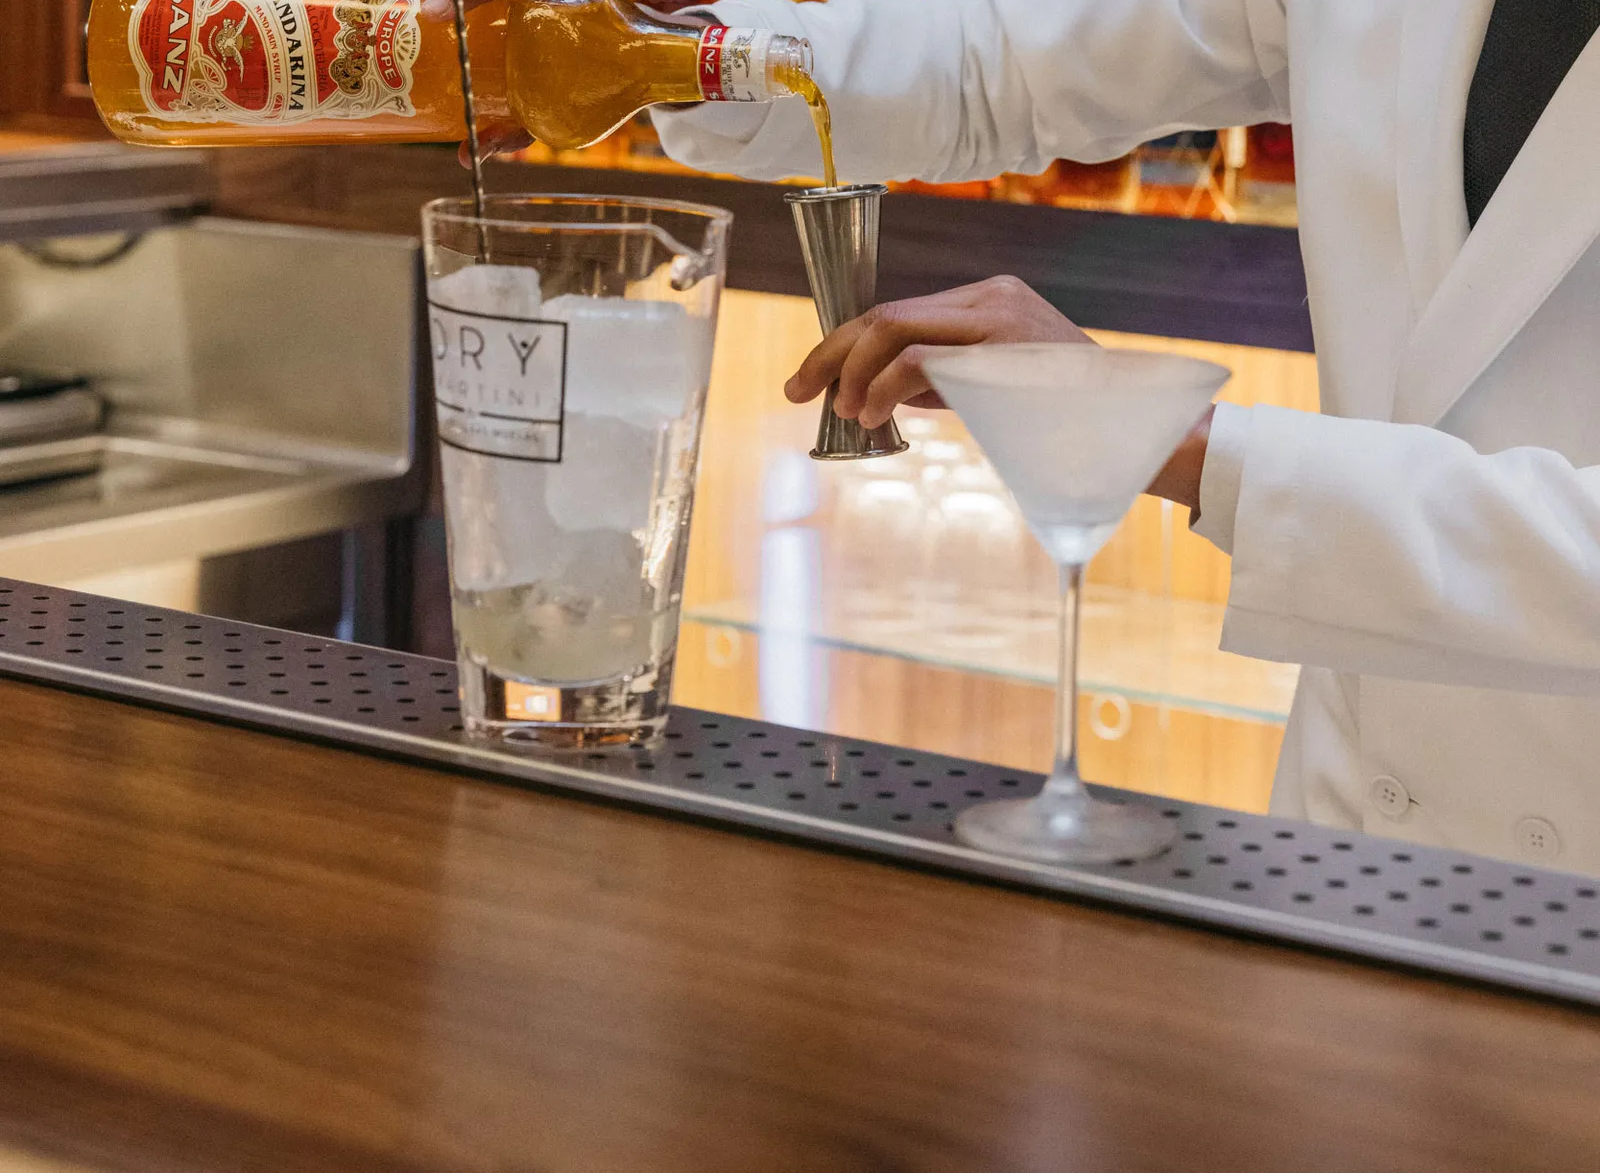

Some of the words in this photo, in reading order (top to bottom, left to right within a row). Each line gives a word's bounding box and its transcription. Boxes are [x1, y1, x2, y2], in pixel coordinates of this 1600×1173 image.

[255, 5, 278, 51] MANDARIN
[272, 52, 281, 83] SYRUP
[379, 8, 400, 80] SIROPE
[705, 28, 722, 74] SANZ
